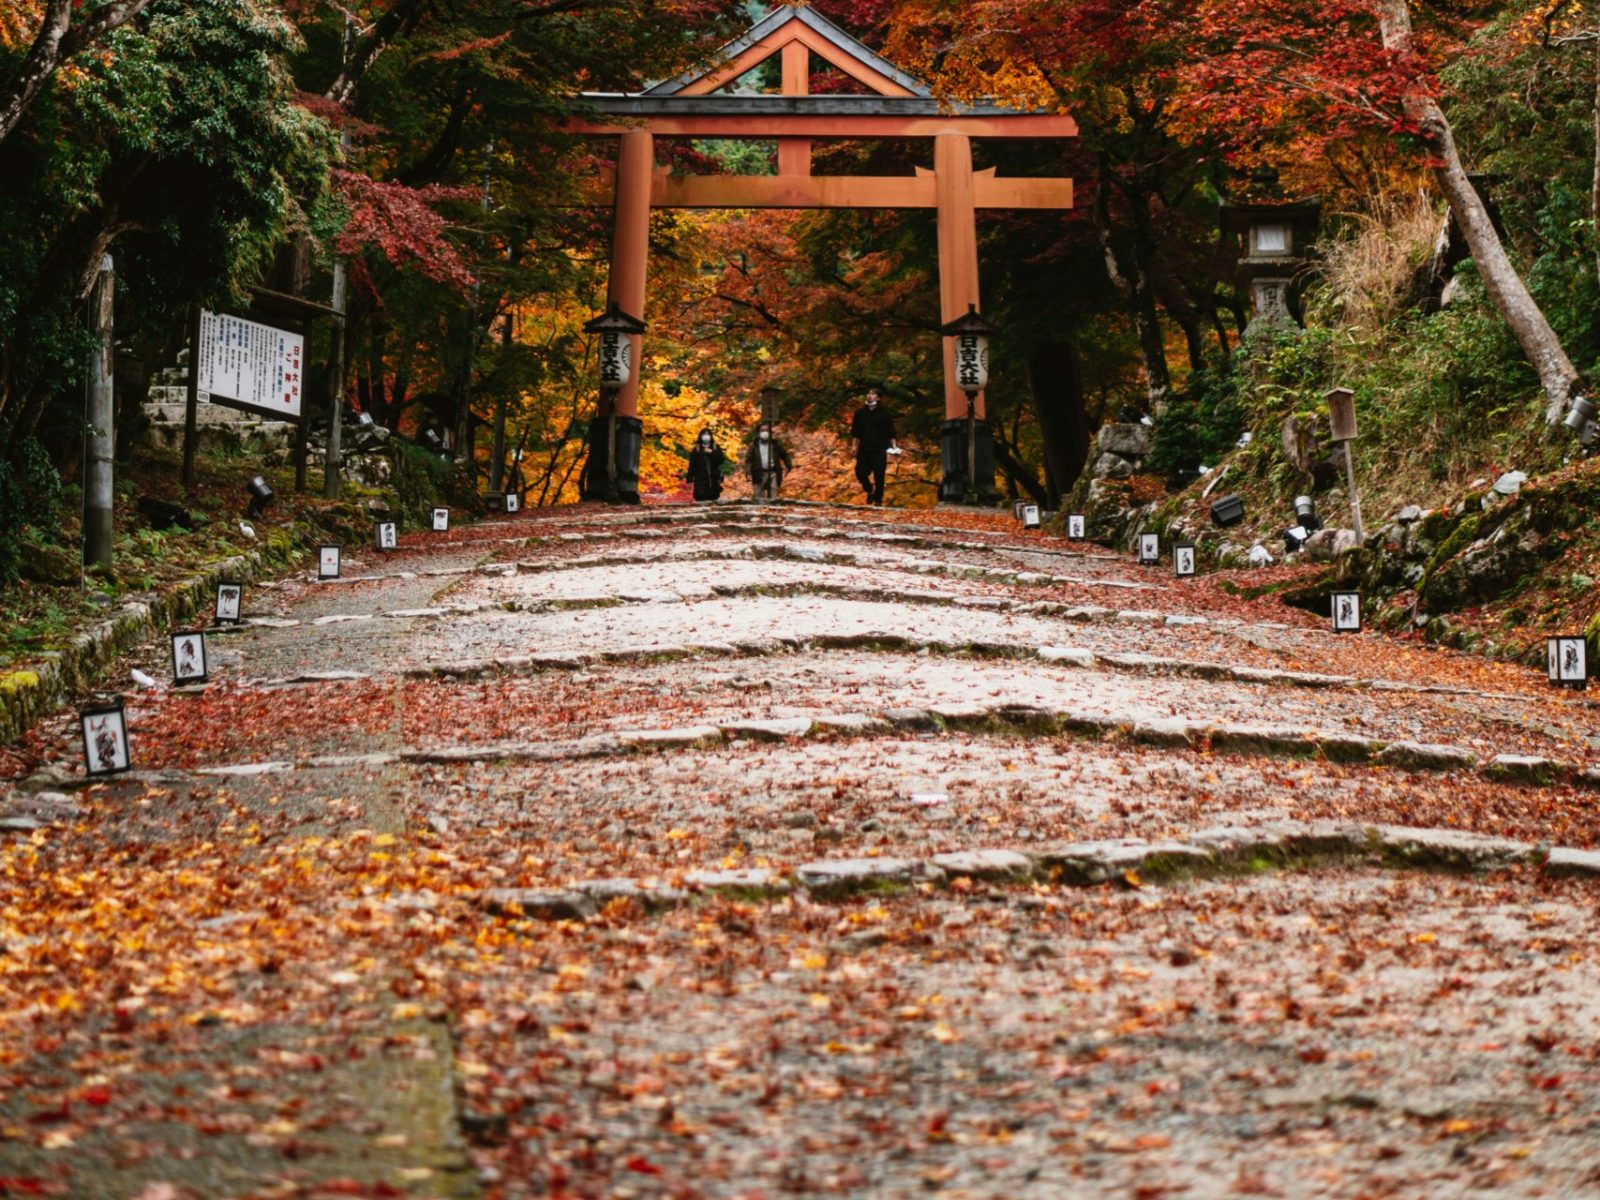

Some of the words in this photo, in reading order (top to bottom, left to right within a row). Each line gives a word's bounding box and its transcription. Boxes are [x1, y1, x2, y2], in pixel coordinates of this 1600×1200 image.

[601, 333, 620, 382] 日吉大社
[960, 336, 979, 385] 日吉大社
